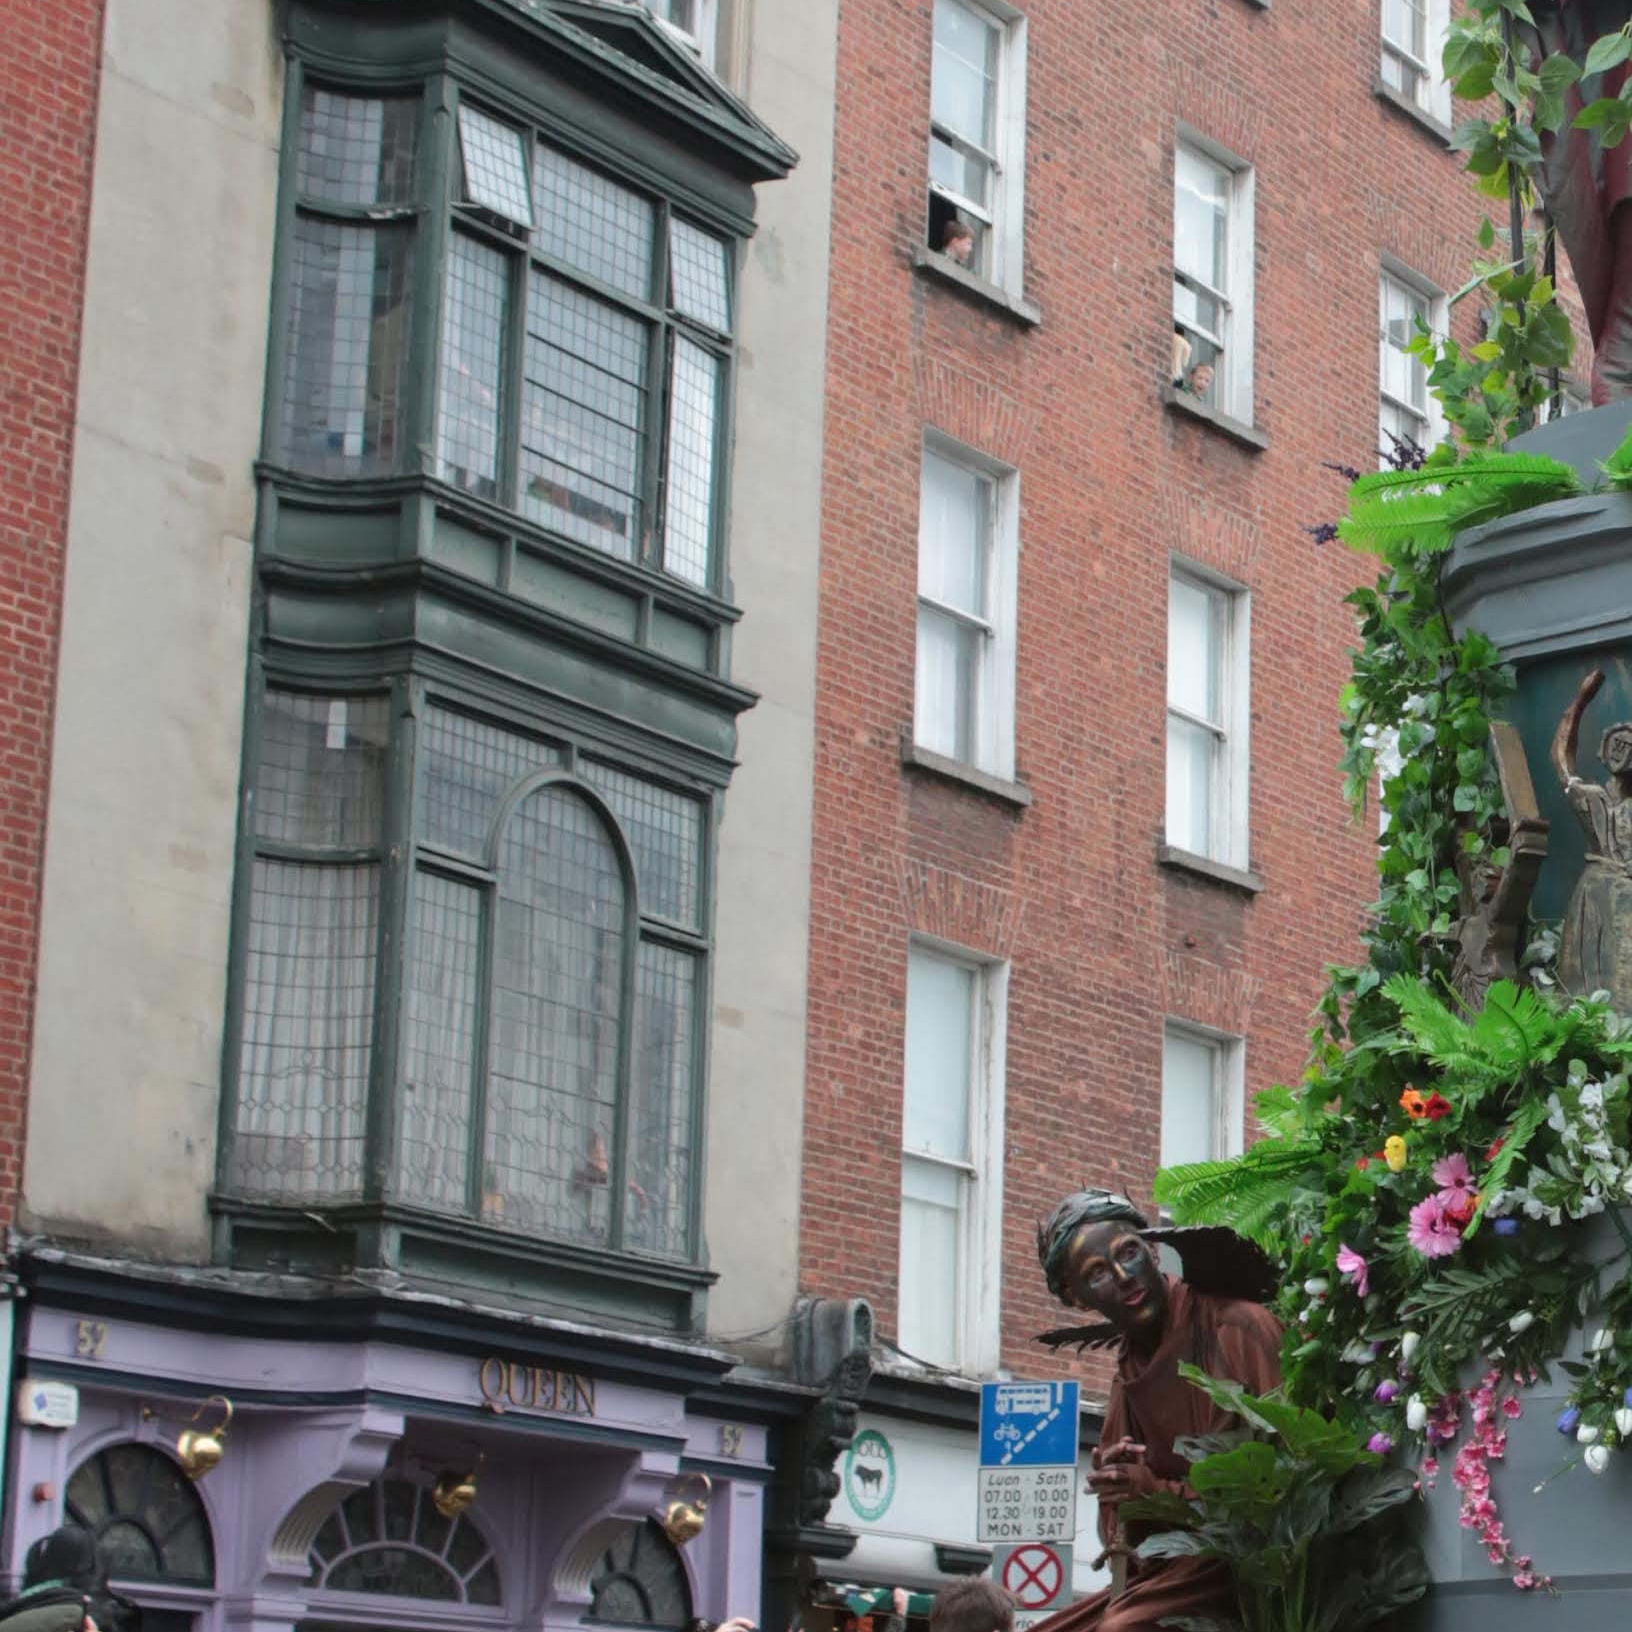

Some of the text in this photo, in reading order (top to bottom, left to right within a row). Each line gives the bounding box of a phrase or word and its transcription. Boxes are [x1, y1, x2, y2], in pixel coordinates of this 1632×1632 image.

[479, 1357, 597, 1416] QUEEN
[987, 1473, 1020, 1486] Luan
[1035, 1472, 1068, 1486] Sath
[984, 1488, 1069, 1504] 07.00 10.00
[986, 1505, 1067, 1520] 12.30 19.00
[987, 1523, 1021, 1536] MON
[1036, 1522, 1064, 1536] SAT
